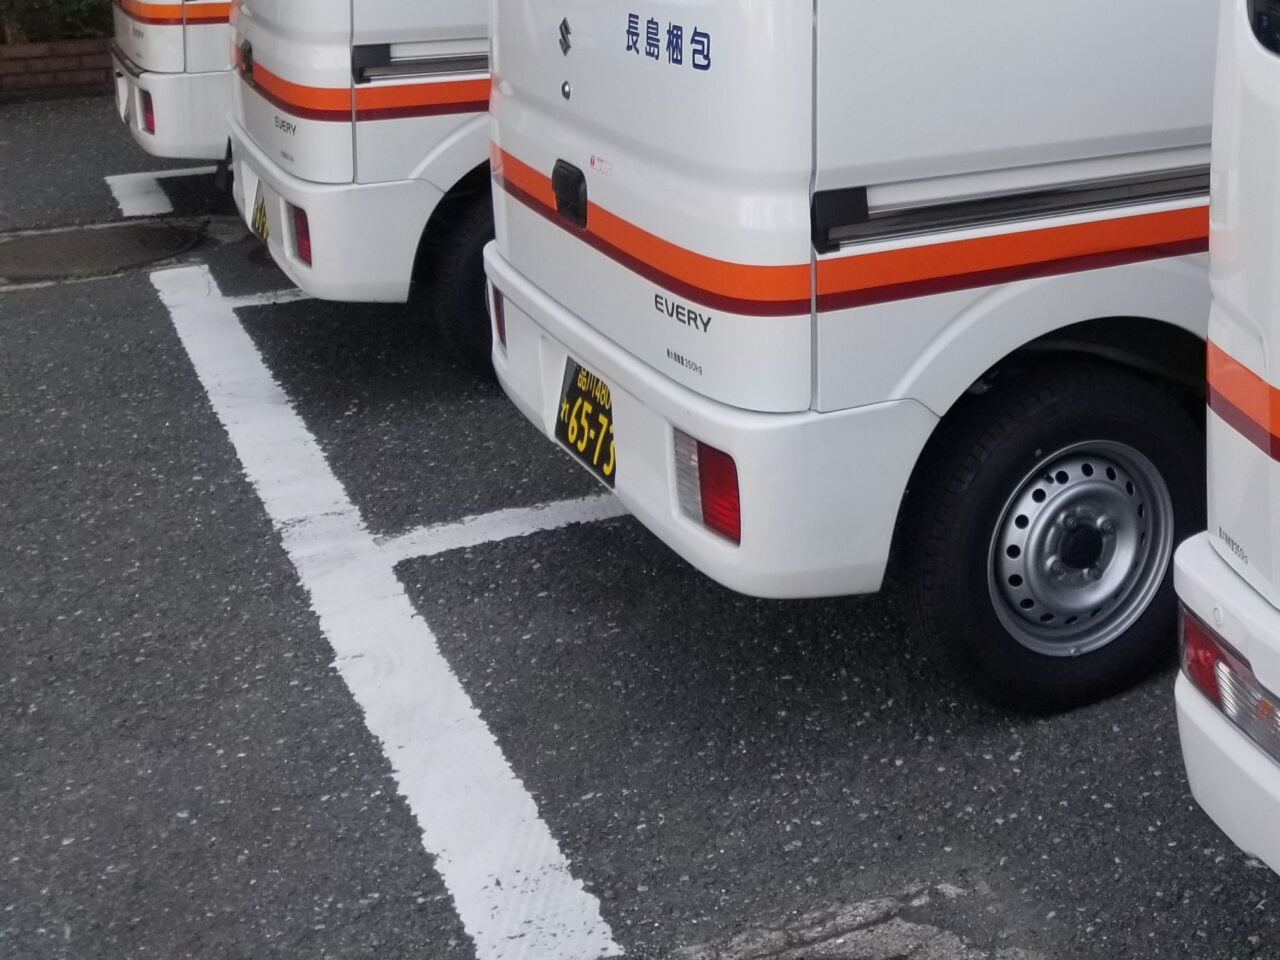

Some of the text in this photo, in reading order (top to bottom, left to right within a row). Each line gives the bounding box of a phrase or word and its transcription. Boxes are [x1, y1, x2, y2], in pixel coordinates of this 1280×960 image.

[626, 13, 712, 71] 長島梱包
[654, 293, 712, 333] EVERY
